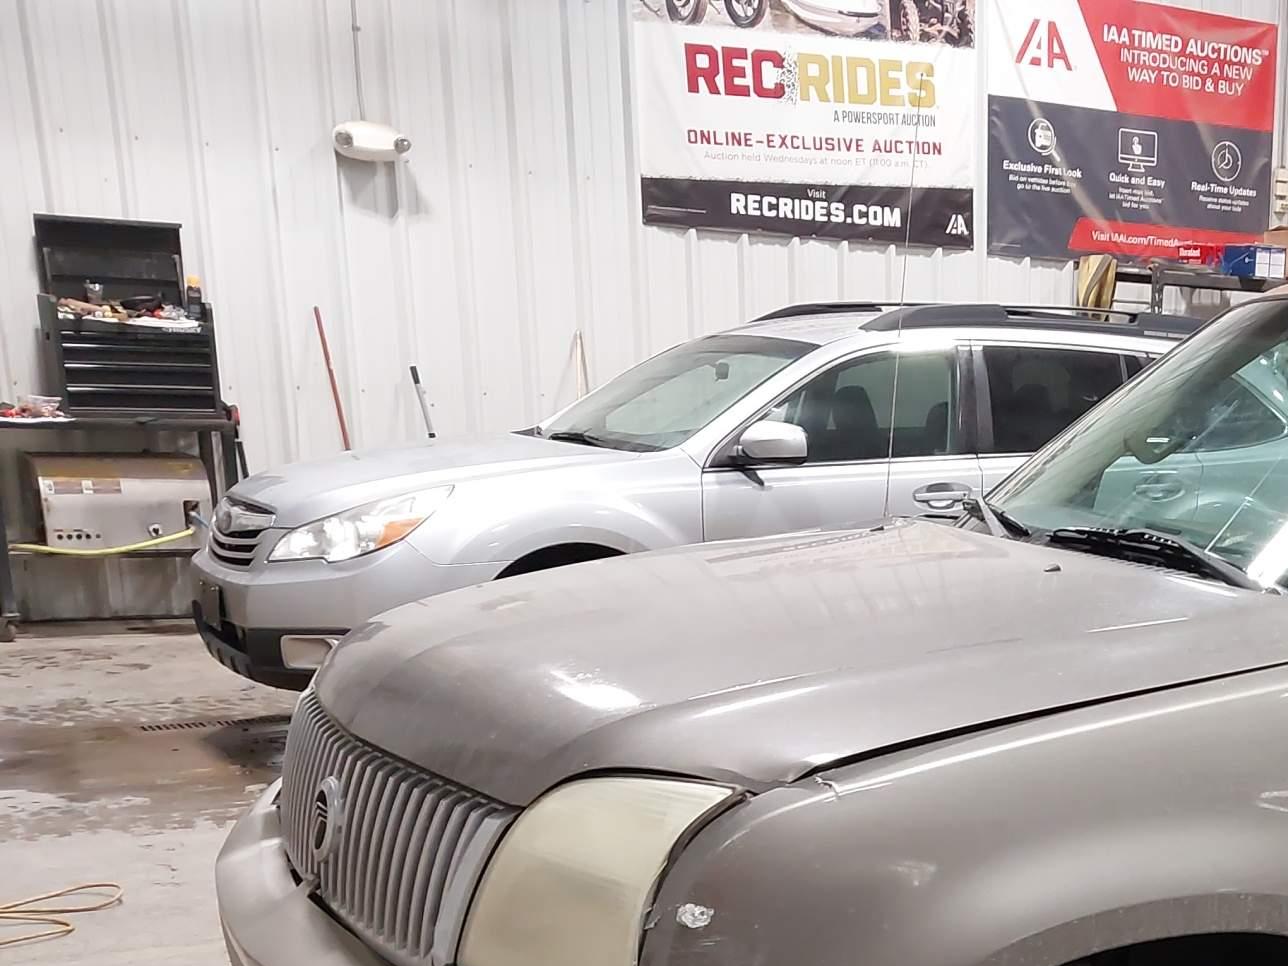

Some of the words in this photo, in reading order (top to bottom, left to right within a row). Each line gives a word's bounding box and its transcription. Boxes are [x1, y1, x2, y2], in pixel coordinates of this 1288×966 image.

[1103, 24, 1130, 45] IAA
[1131, 29, 1182, 53] TIMED
[1120, 48, 1208, 75] INTRODUCING
[1211, 62, 1221, 76] A
[1223, 65, 1253, 80] NEW
[684, 42, 786, 99] REC
[797, 53, 936, 109] RIDES
[1127, 66, 1159, 84] WAY
[1161, 71, 1179, 87] TO
[1182, 74, 1202, 90] BID
[1204, 78, 1215, 93] &
[1218, 80, 1244, 96] BUY
[833, 110, 840, 123] A
[842, 110, 900, 126] POWERSPORT
[901, 115, 936, 128] AUCTION
[687, 129, 864, 153] ONLINE-EXCLUSIVE
[872, 139, 943, 156] AUCTION
[704, 151, 739, 162] Auction
[741, 153, 761, 162] held
[763, 154, 817, 167] Wednesdays
[830, 158, 853, 166] noon
[1002, 160, 1043, 174] Exclusive
[1043, 164, 1062, 176] First
[1109, 172, 1130, 184] Quick
[1130, 175, 1146, 185] and
[1147, 176, 1166, 189] Easy
[1190, 181, 1228, 195] Real-Time
[1229, 185, 1257, 198] Updates
[807, 188, 826, 199] Visit
[730, 192, 902, 229] RECRIDES.COM
[1091, 231, 1111, 242] Visit
